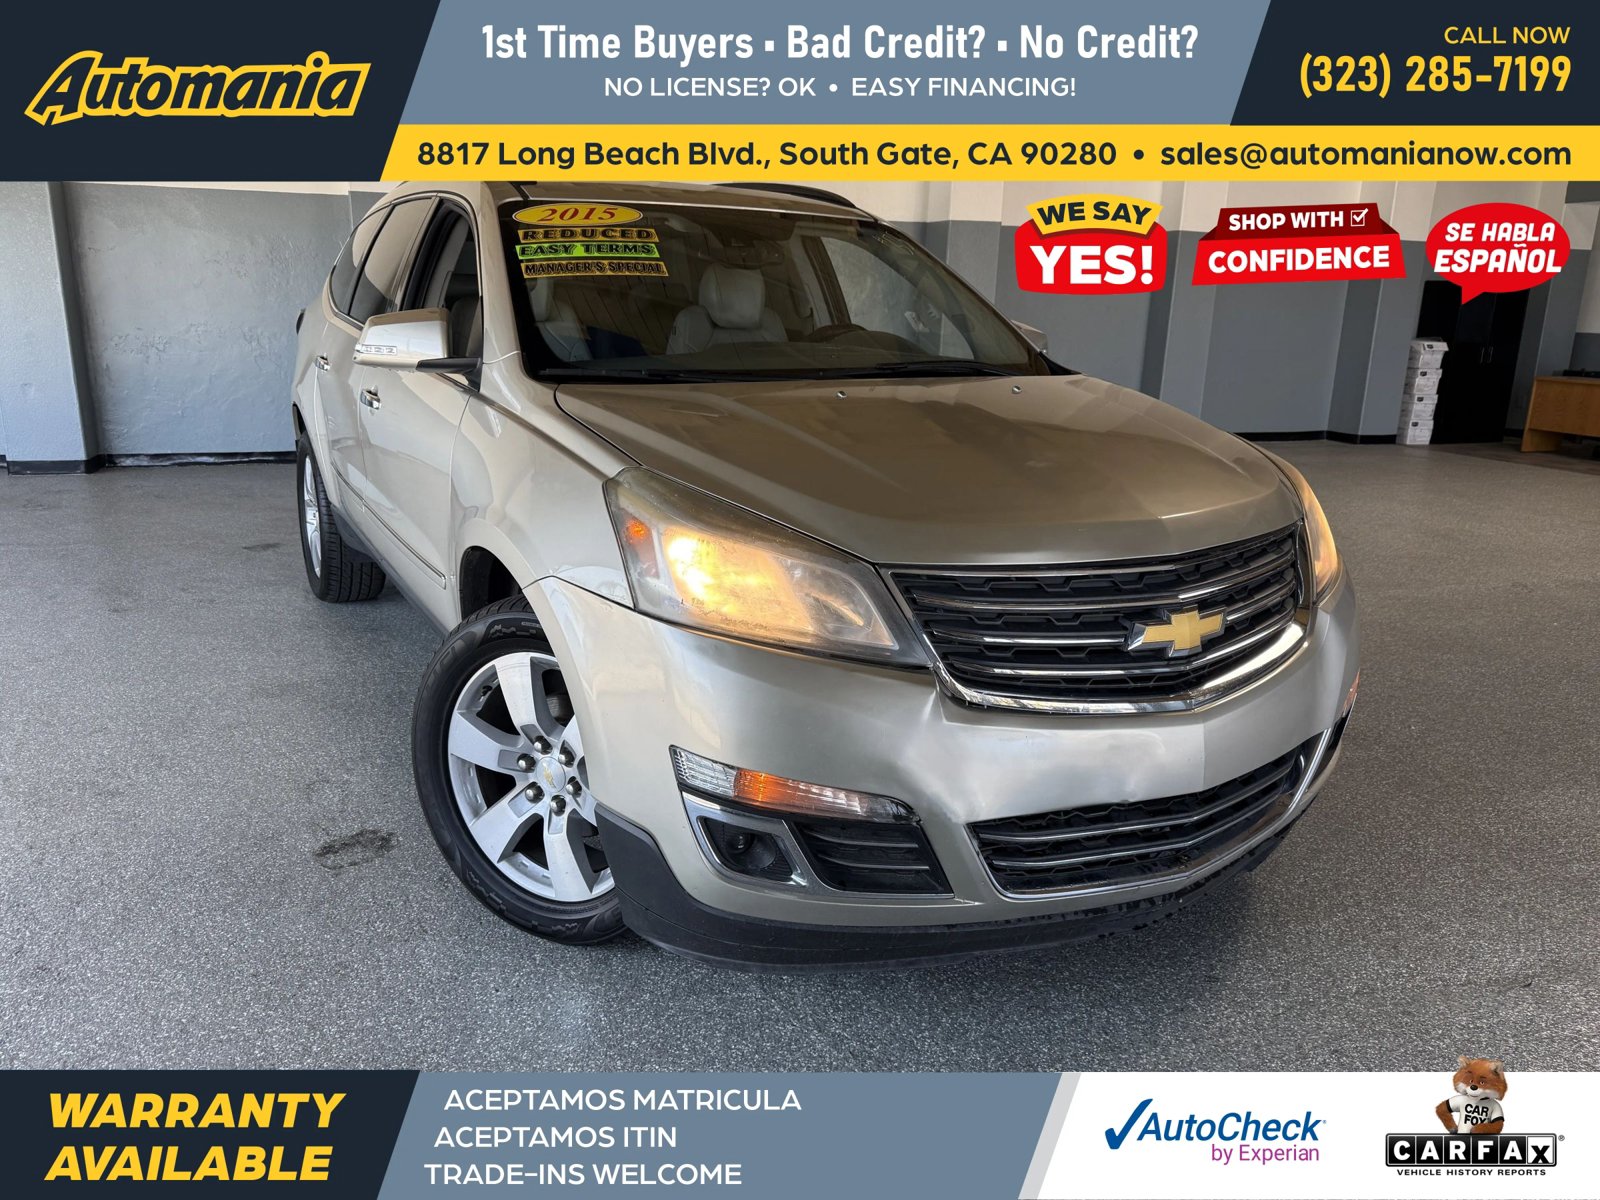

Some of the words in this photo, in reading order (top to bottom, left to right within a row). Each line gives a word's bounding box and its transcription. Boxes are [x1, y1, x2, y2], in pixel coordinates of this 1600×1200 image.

[537, 207, 619, 222] 2015
[522, 229, 655, 242] REDUCED
[521, 244, 577, 257] EASY
[581, 244, 656, 256] TERMS
[525, 262, 606, 276] MANAGER'S
[608, 261, 666, 276] SPECIAL
